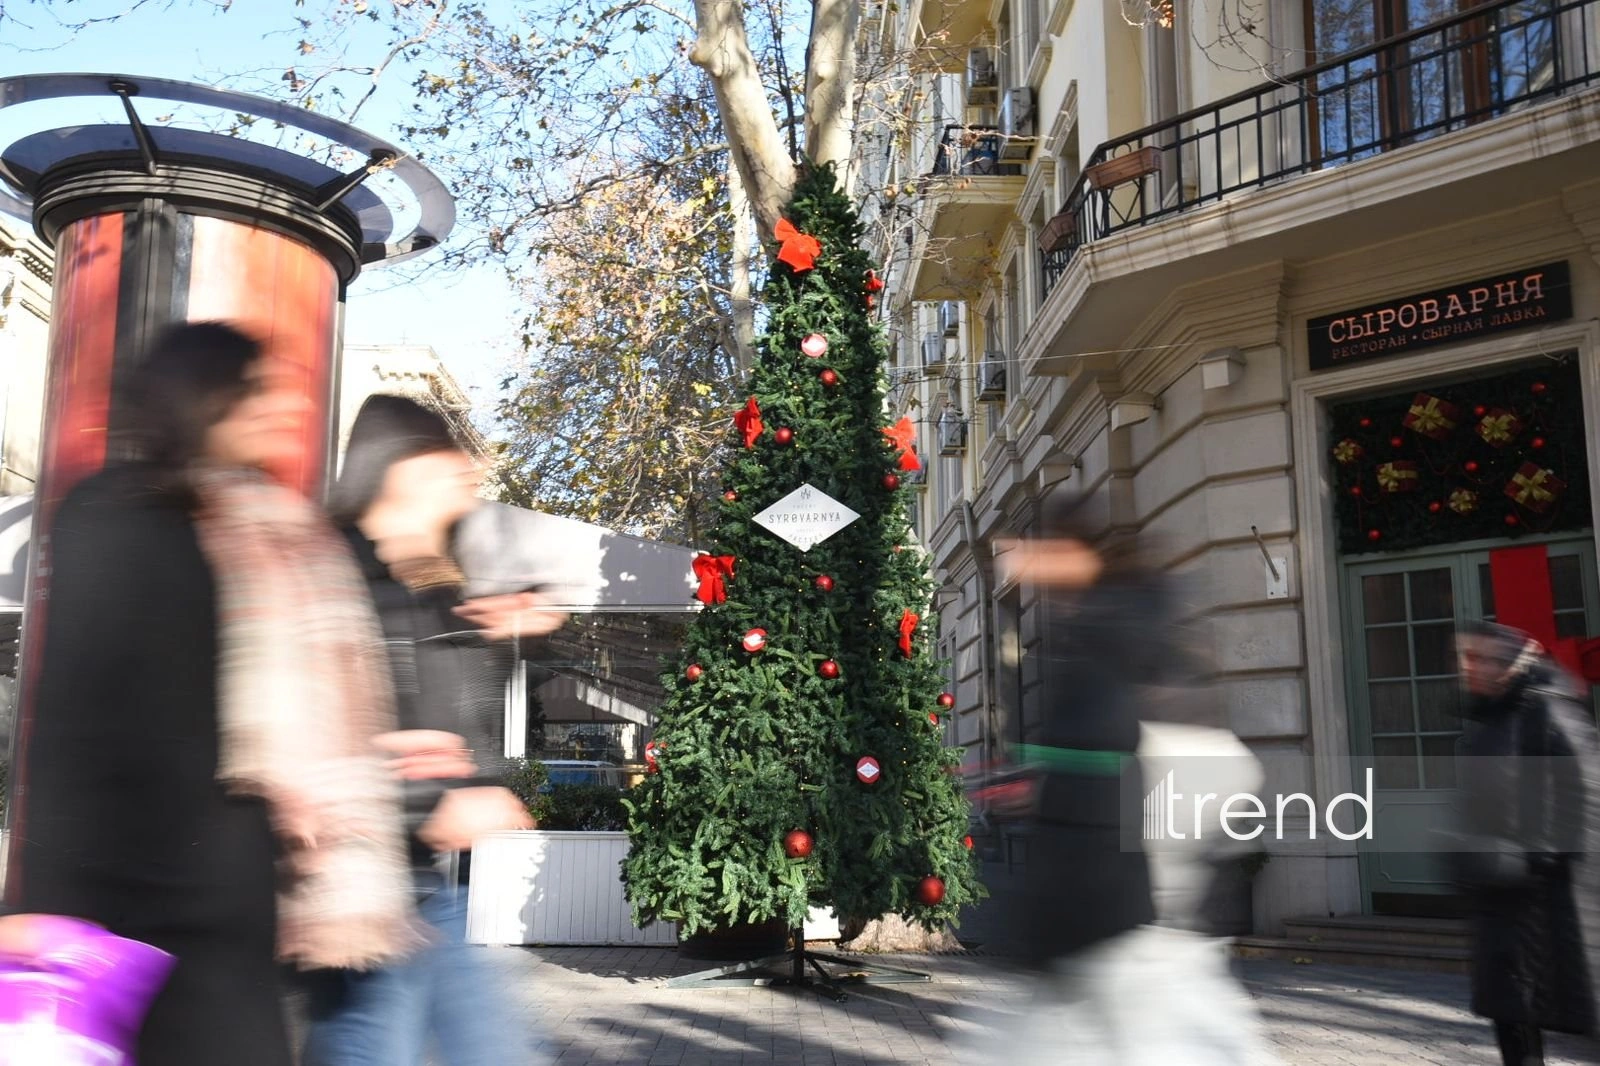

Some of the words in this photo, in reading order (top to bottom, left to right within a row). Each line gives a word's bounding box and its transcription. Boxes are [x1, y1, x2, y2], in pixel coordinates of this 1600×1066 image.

[1328, 273, 1544, 344] СЫРОВАРНЯ
[1332, 335, 1407, 359] РЕСТОРАН
[1422, 321, 1483, 341] СЫРНАЯ
[1490, 305, 1545, 326] ЛАВКА
